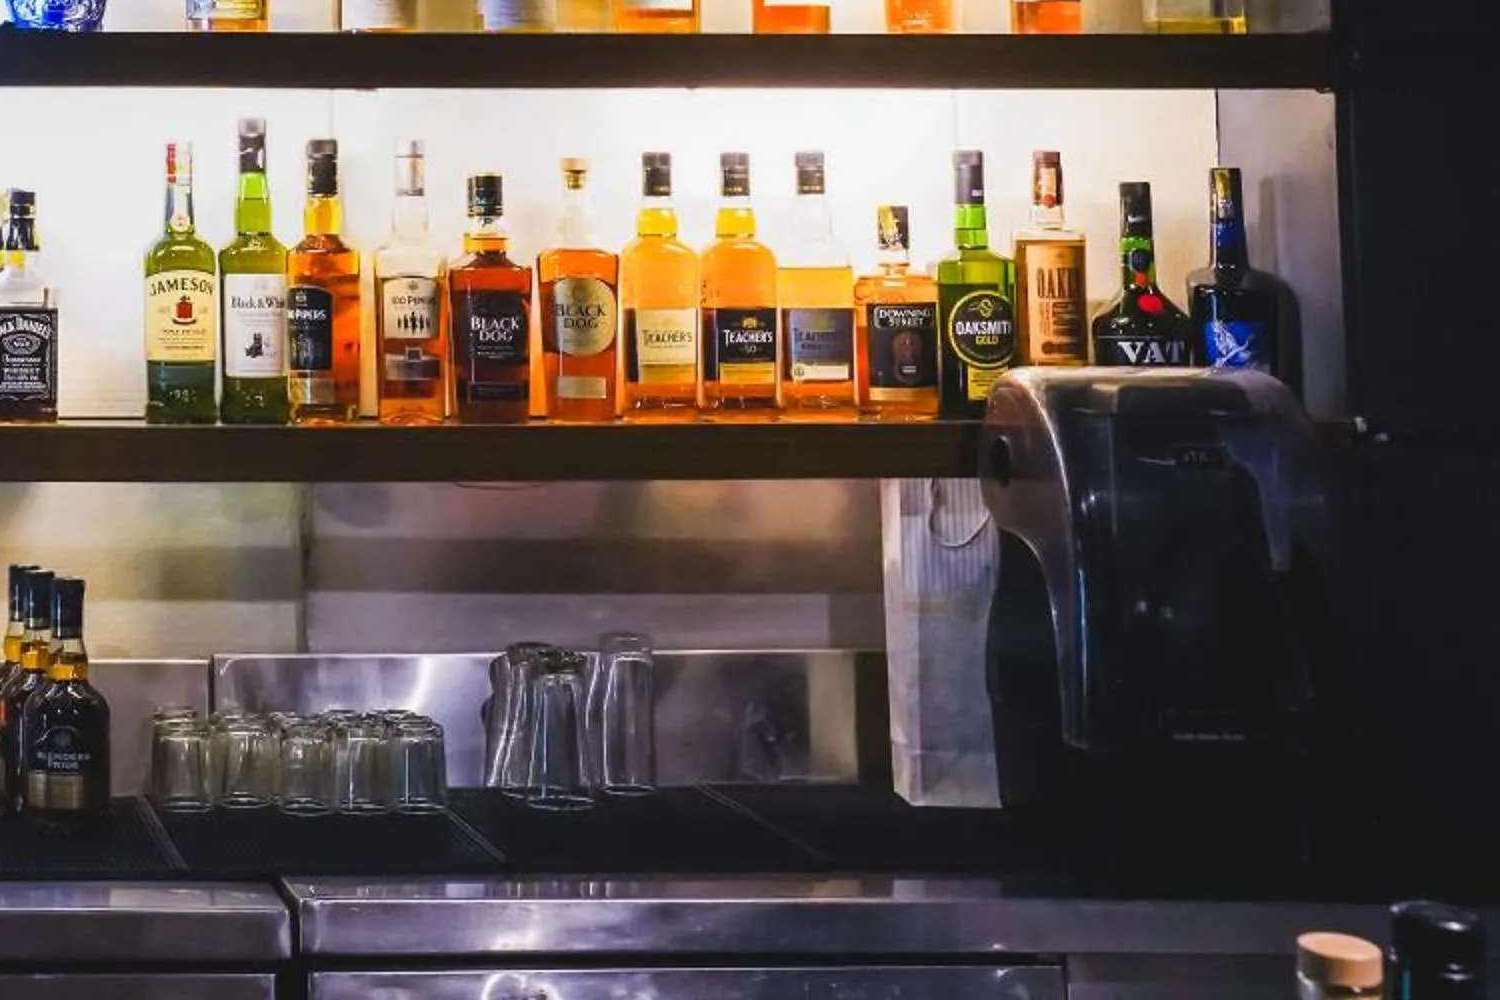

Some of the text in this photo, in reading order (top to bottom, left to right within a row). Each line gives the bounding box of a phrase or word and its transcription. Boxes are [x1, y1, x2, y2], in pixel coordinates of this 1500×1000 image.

[149, 277, 214, 297] JAMESON
[555, 302, 607, 317] BLACK
[879, 307, 932, 319] DOWNING
[470, 315, 520, 331] BLACK
[563, 317, 599, 329] DOG
[888, 317, 924, 327] STREET
[479, 330, 514, 342] DOG
[642, 329, 693, 347] TEACHER'S
[723, 329, 774, 348] TEACHER'S
[975, 335, 999, 346] GOLD
[1117, 340, 1186, 365] VAT
